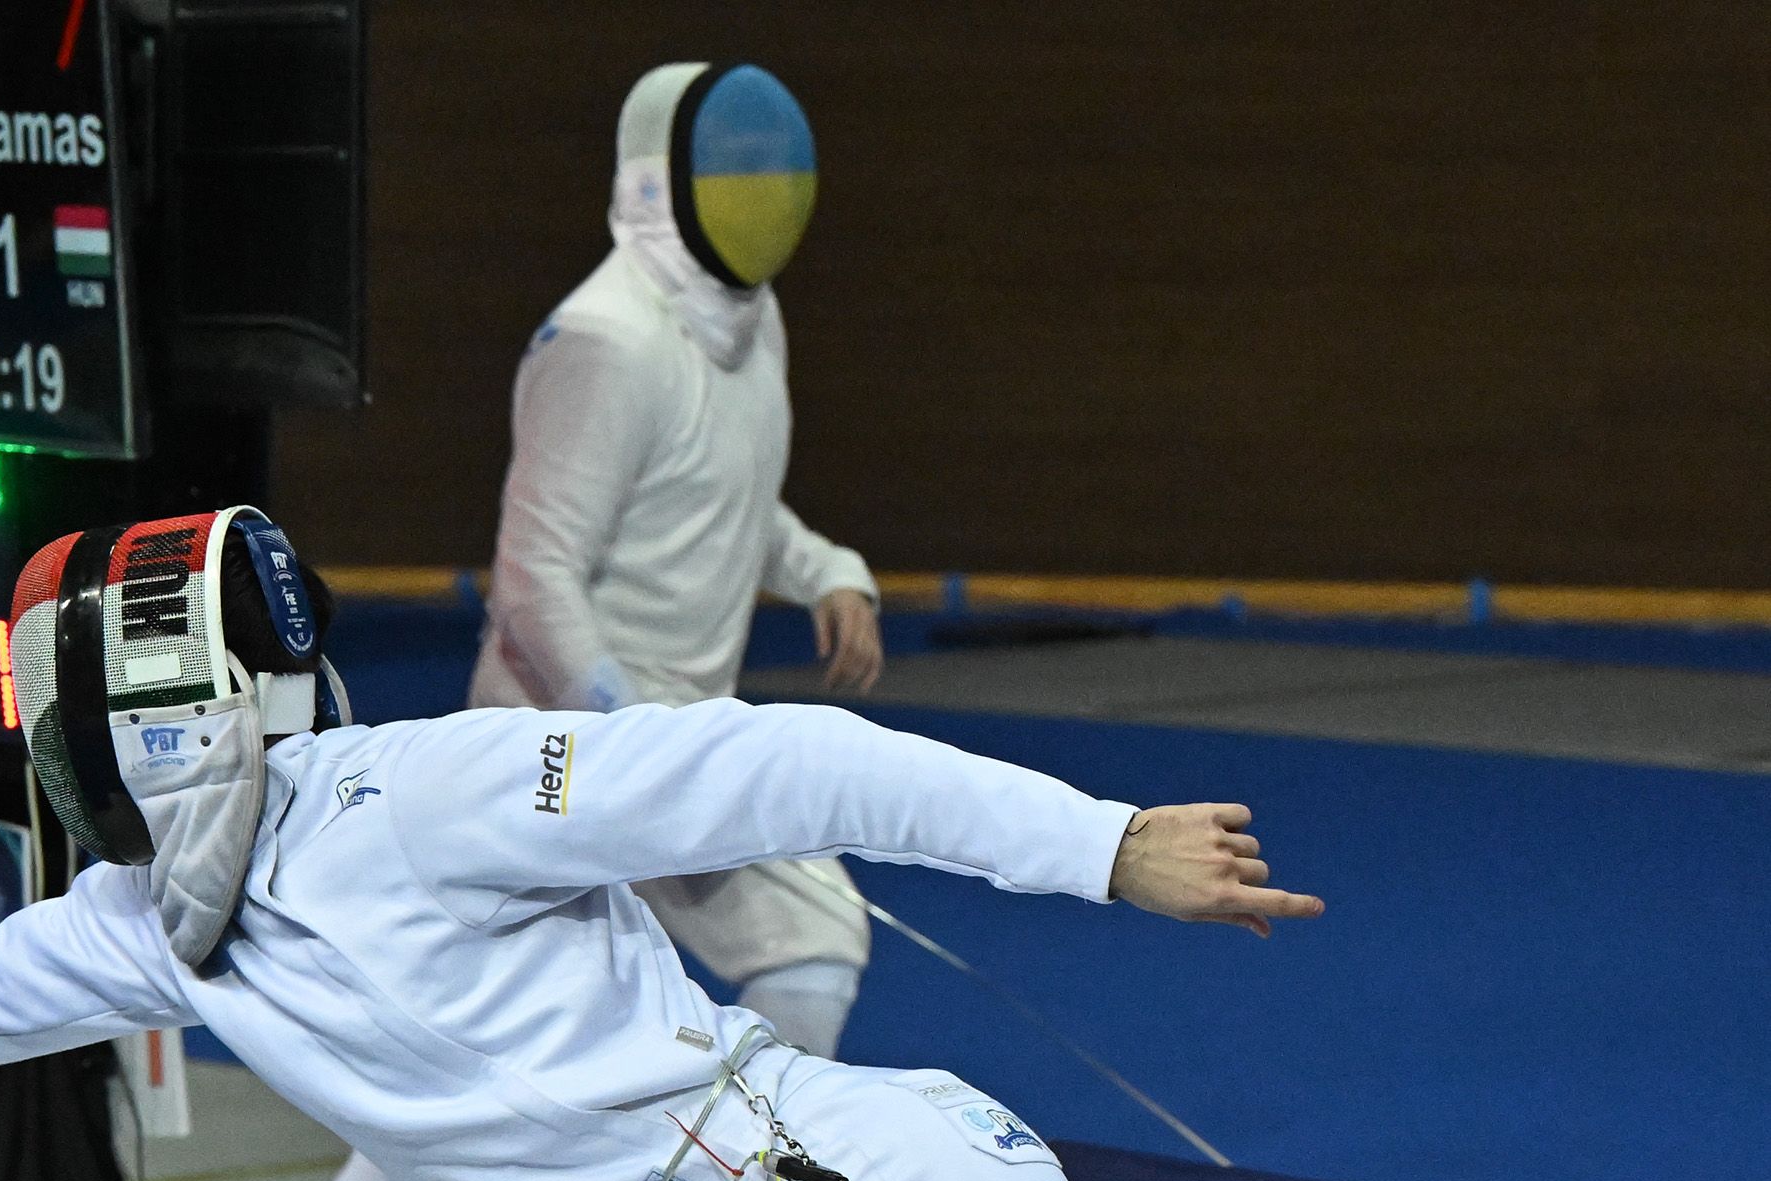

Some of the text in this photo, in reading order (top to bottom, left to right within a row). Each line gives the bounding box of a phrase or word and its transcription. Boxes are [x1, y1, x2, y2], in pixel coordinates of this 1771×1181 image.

[122, 527, 197, 642] HUN
[141, 727, 185, 755] PBT
[534, 733, 569, 815] Hertz
